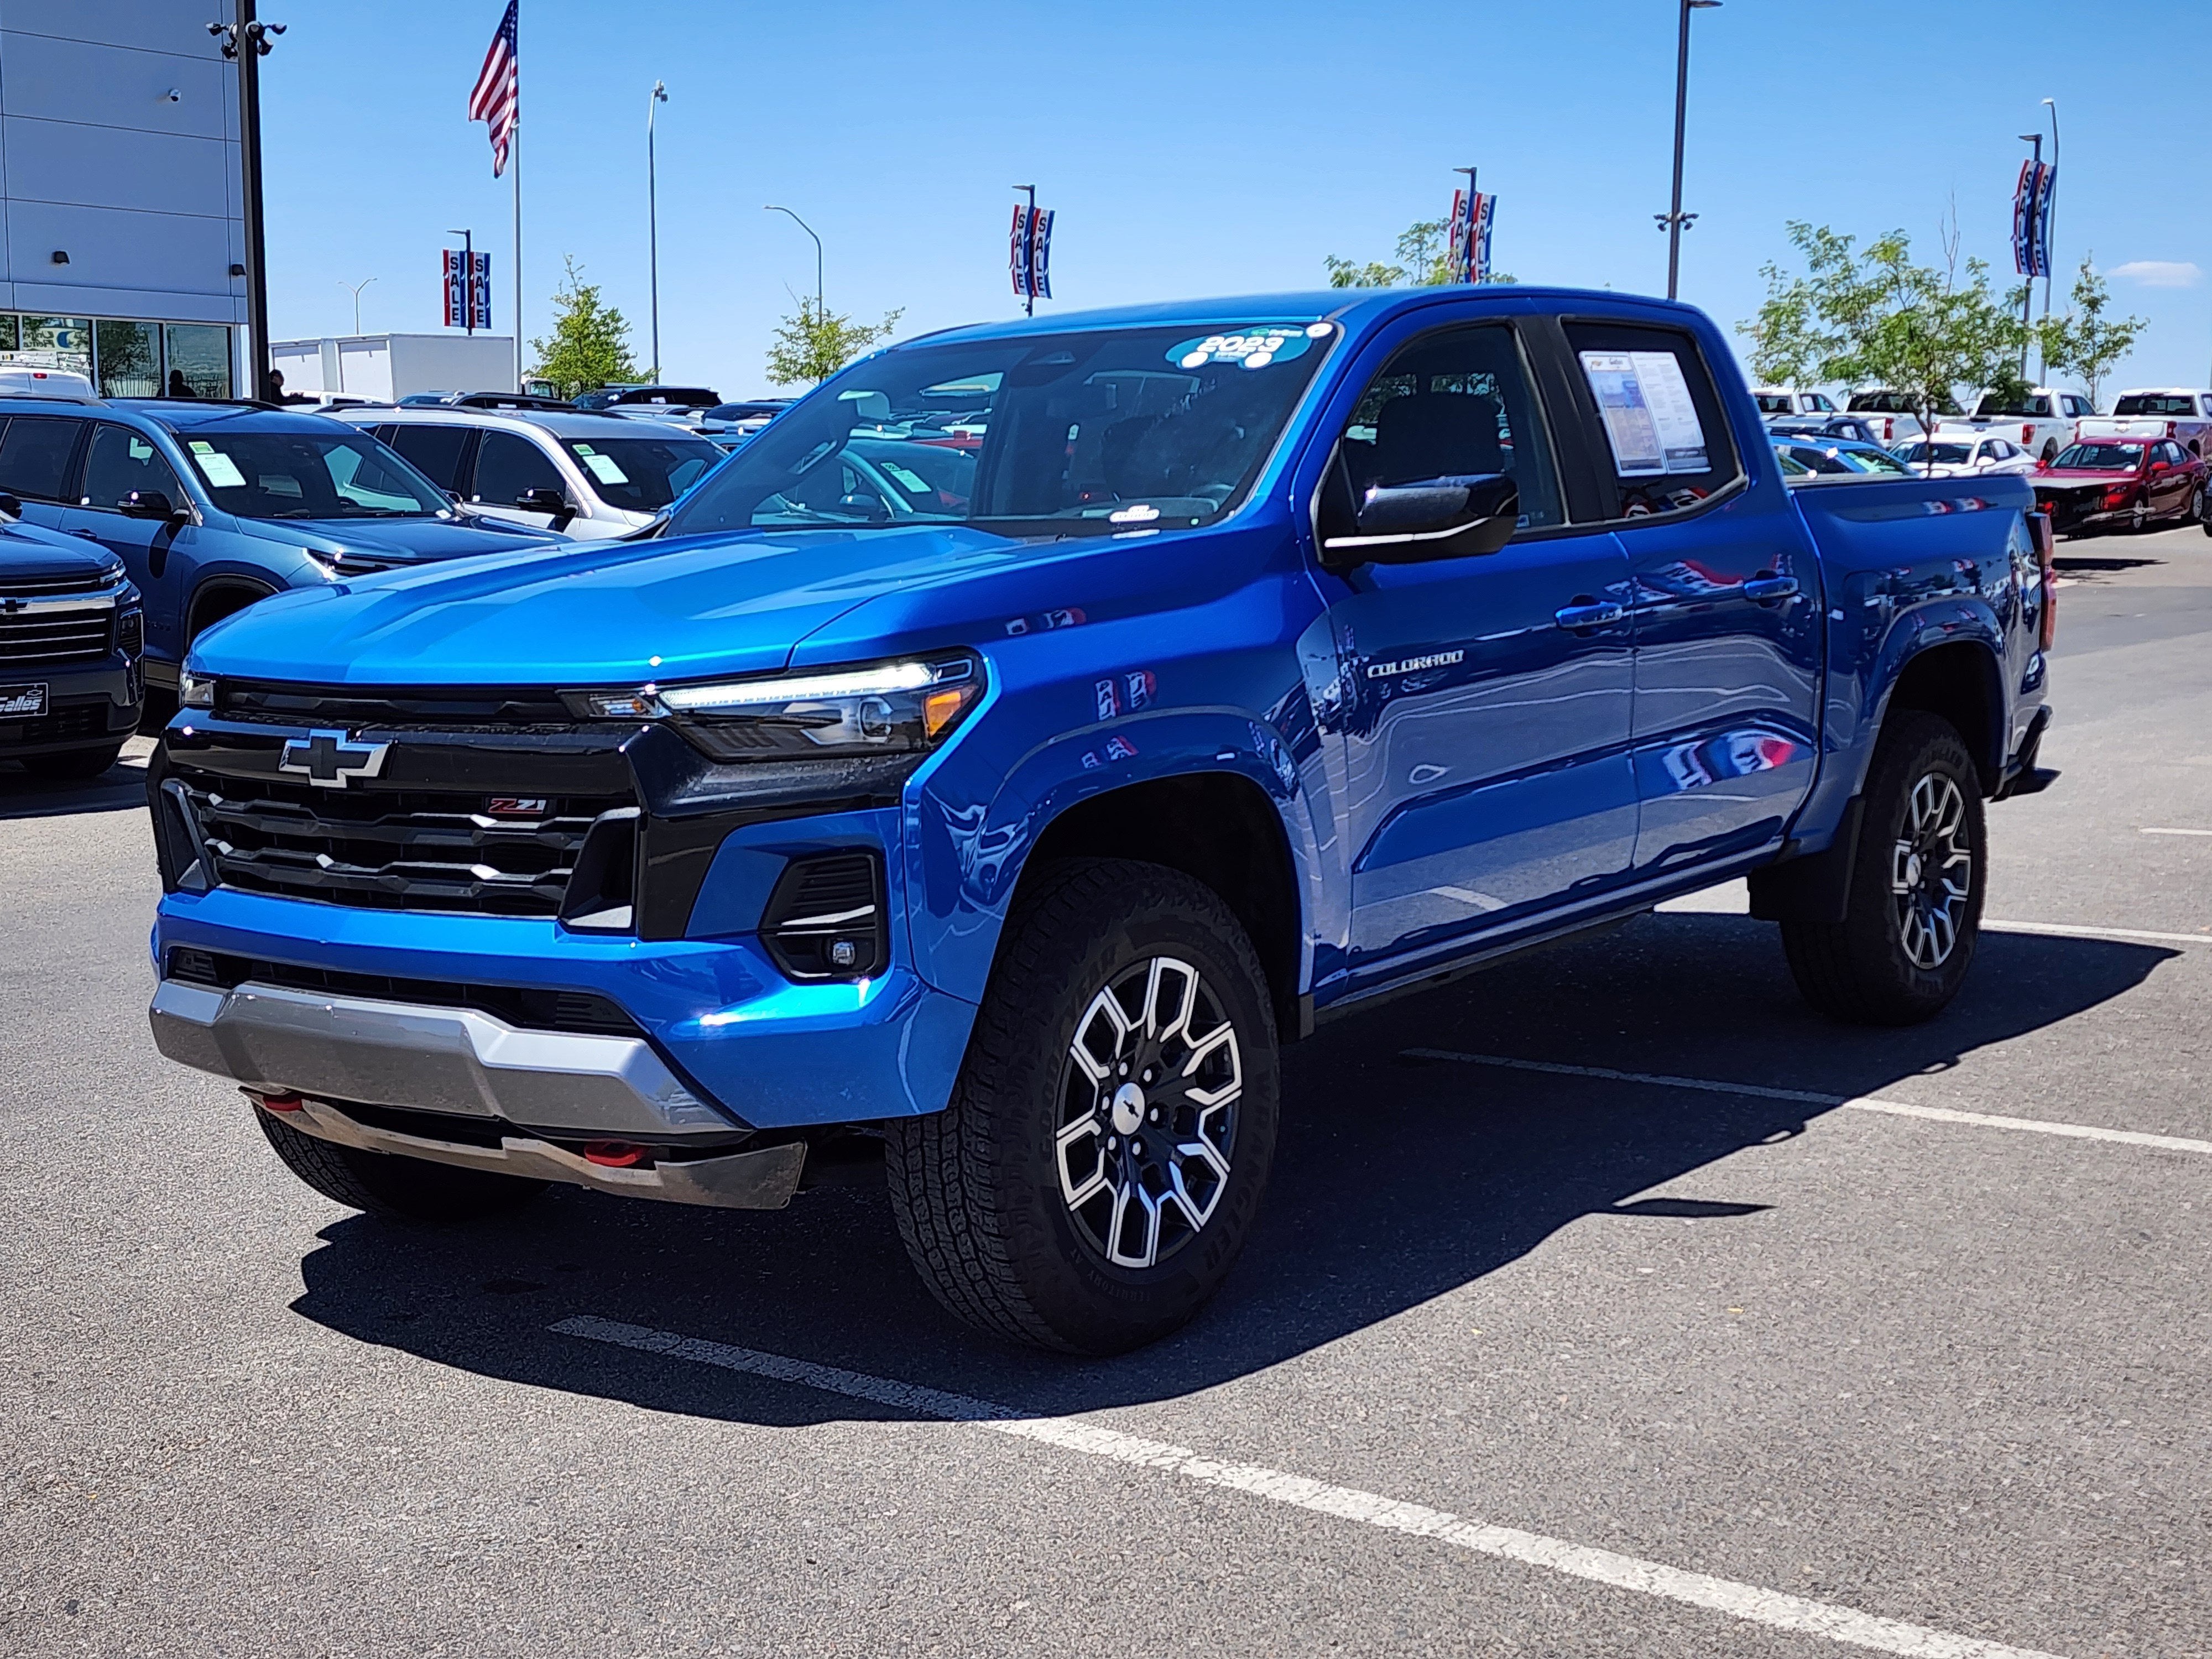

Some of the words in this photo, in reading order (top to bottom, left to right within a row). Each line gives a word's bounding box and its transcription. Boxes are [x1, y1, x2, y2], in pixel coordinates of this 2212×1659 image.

[1015, 213, 1026, 289] SALE
[1035, 216, 1047, 291] SALE
[1455, 199, 1468, 283] SAL
[2018, 171, 2032, 266] SALE
[2035, 175, 2048, 269] SALE
[450, 257, 460, 321] SALE
[475, 259, 484, 323] SALE
[1368, 650, 1464, 679] COLORADO
[488, 798, 547, 814] Z71
